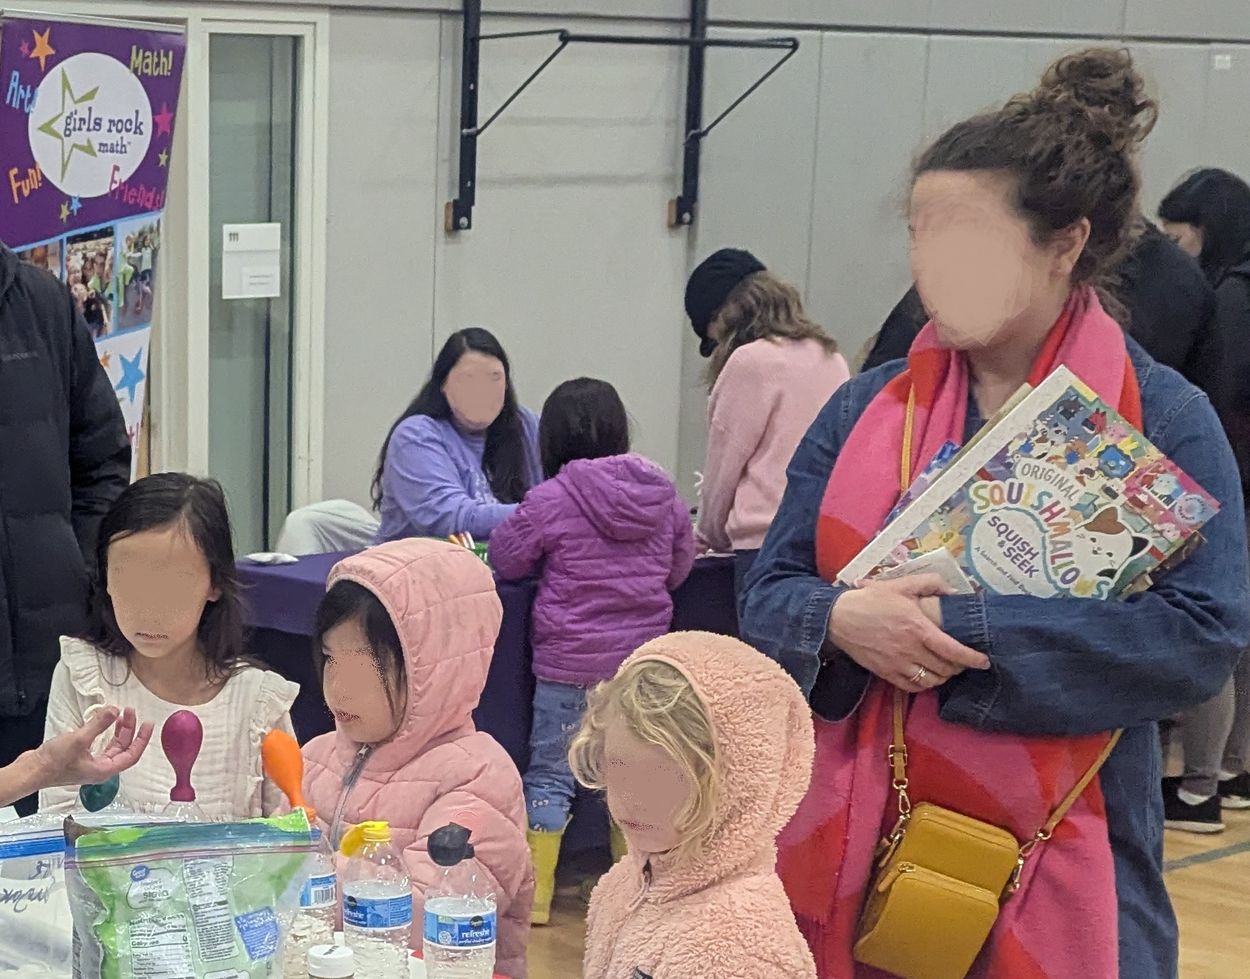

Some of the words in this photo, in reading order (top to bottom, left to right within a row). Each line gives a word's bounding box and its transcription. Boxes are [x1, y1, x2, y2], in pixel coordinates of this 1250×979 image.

[130, 45, 173, 77] Math!
[5, 70, 38, 114] Art!
[63, 107, 103, 138] girls
[107, 110, 144, 136] rock
[9, 162, 42, 204] Fun!
[108, 165, 166, 210] Friends!
[229, 232, 239, 242] 111
[1021, 463, 1080, 501] ORIGINAL
[987, 515, 1040, 561] SQUISH
[997, 540, 1006, 549] &
[1003, 546, 1040, 578] SEEK
